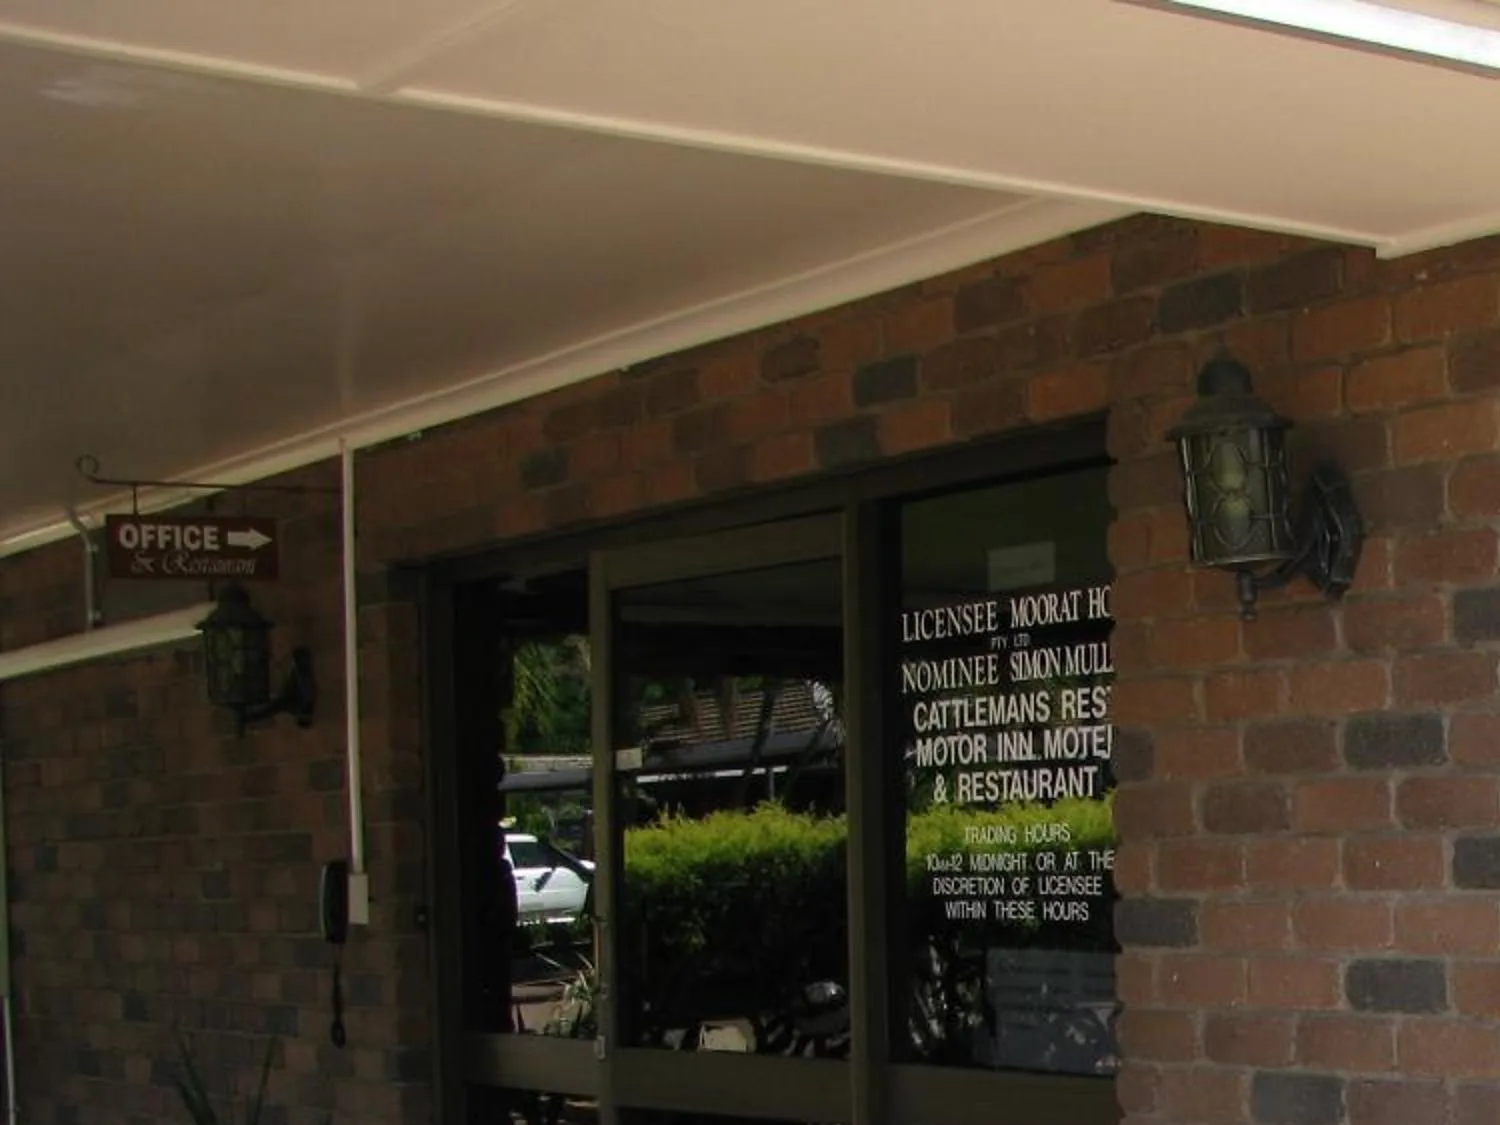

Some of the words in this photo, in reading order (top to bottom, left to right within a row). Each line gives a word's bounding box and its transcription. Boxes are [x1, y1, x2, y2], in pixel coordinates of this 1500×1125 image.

[119, 523, 220, 551] OFFICE
[902, 601, 998, 642] LICENSEE
[1010, 590, 1081, 628] MOORAT
[902, 654, 999, 693] NOMINEE
[1010, 647, 1061, 682] SIMON
[1065, 642, 1114, 676] MULL
[913, 691, 1050, 732] CATTLEMANS
[1061, 685, 1112, 720] RES
[916, 732, 987, 767] MOTOR
[934, 773, 949, 803] &
[958, 766, 1098, 802] RESTAURANT
[965, 825, 1016, 844] TRADING
[1024, 823, 1071, 843] HOURS
[969, 853, 1027, 871] MIDNIGHT
[1036, 852, 1054, 871] OR
[1064, 851, 1079, 870] AT
[1088, 850, 1114, 869] THE
[933, 877, 1004, 895] DISCRETION
[1012, 877, 1031, 894] OF
[1038, 875, 1102, 896] LICENSEE
[945, 901, 986, 920] WITHIN
[994, 901, 1035, 919] THESE
[1043, 901, 1089, 921] HOURS
